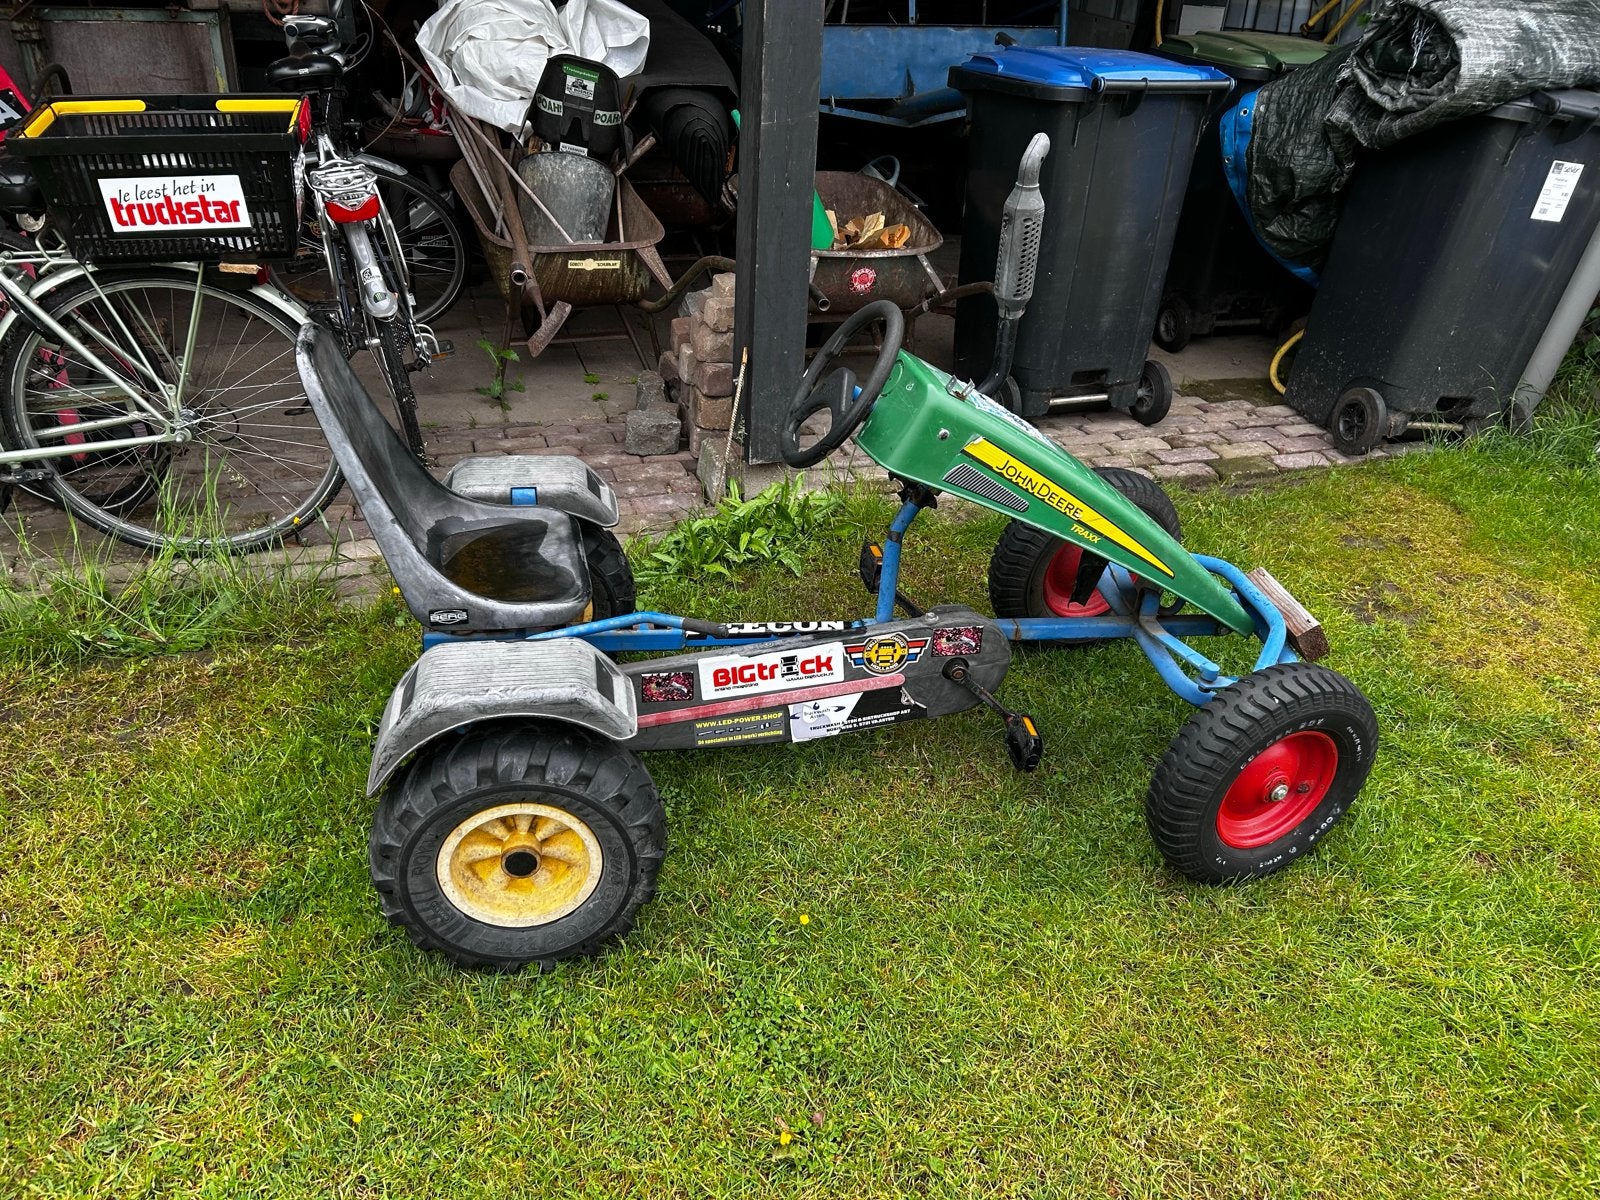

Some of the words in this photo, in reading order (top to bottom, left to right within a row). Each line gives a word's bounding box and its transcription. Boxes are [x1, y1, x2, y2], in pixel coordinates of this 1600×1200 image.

[537, 96, 562, 113] POAH!
[118, 189, 130, 206] Je
[135, 184, 167, 200] leest
[173, 180, 196, 196] het
[201, 179, 216, 193] in
[110, 195, 241, 227] truckstar
[996, 459, 1038, 491] JOHN
[1037, 483, 1084, 519] DEERE
[1070, 523, 1101, 544] TRAXX
[430, 612, 468, 622] BERG
[870, 662, 899, 672] HOLLAND
[696, 712, 783, 729] WWW.LED-POWER.SHOP
[810, 721, 841, 731] TRUCKWASH
[705, 736, 728, 745] specialist
